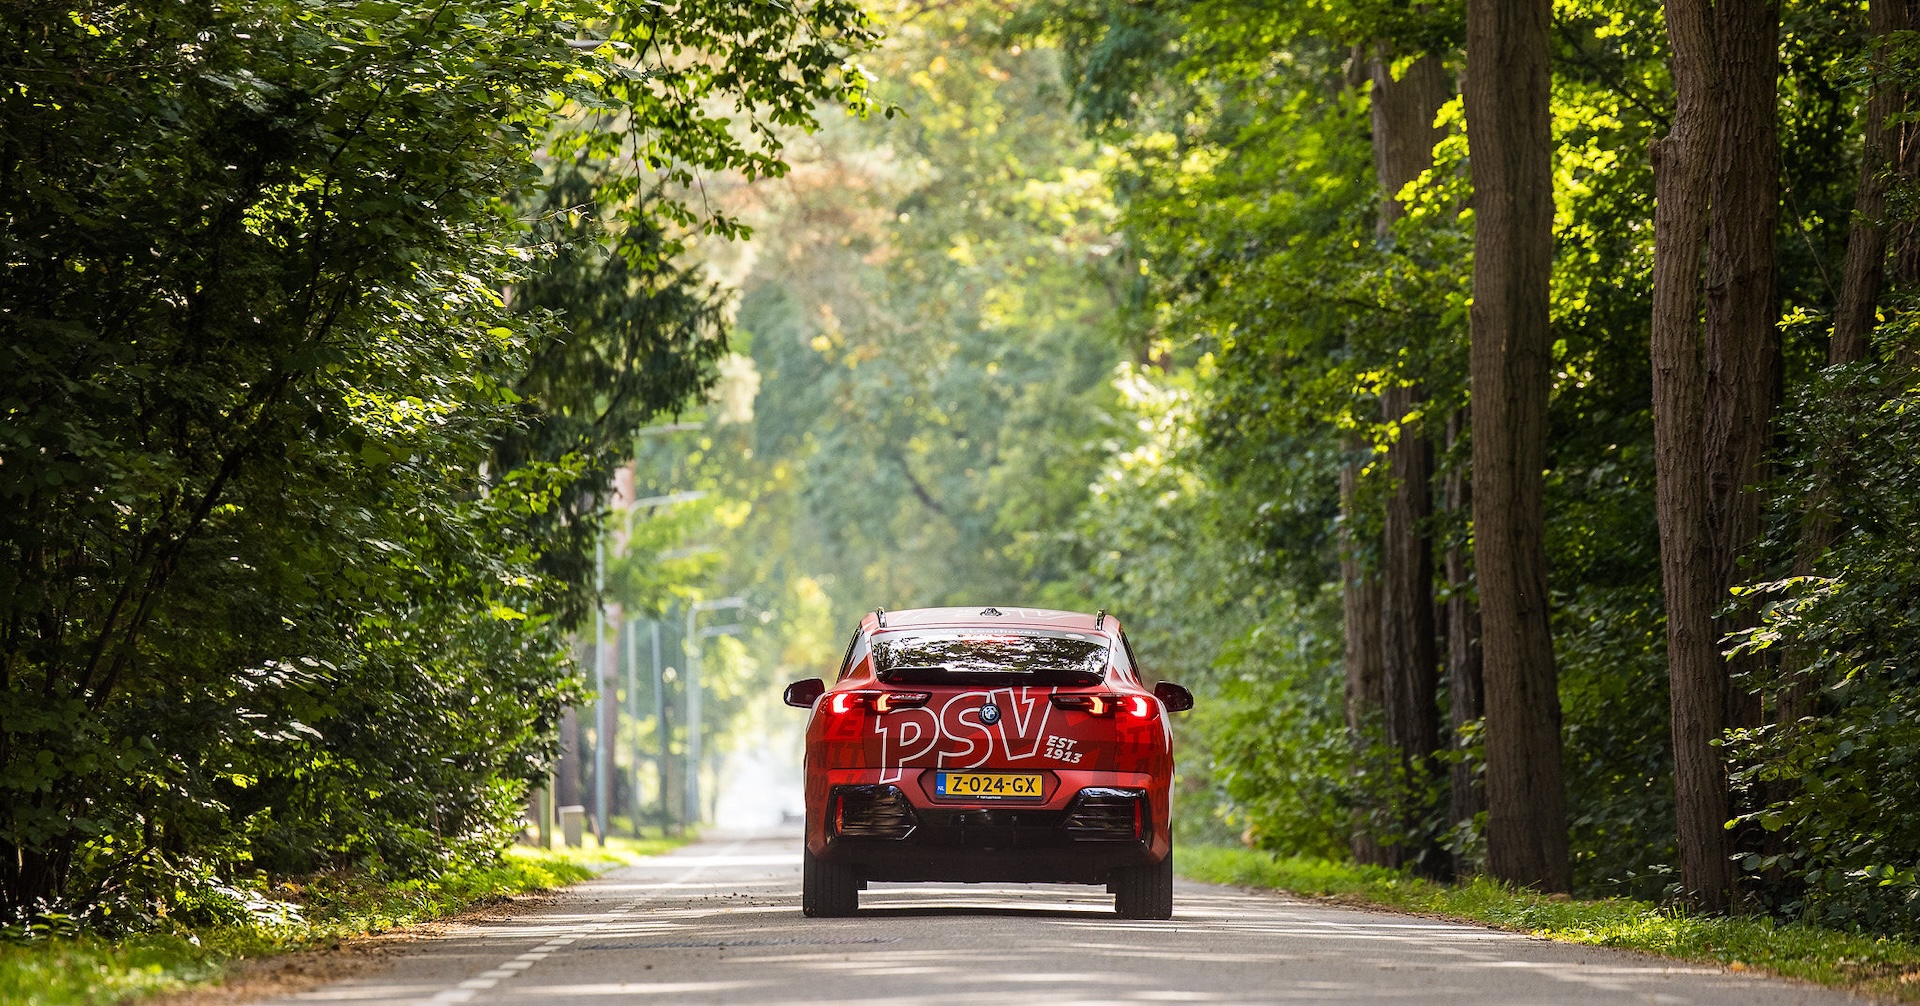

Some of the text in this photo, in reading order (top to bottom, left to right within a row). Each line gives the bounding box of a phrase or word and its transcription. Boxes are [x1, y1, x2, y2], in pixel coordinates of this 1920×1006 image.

[875, 685, 1058, 785] PSV
[1046, 735, 1077, 751] EST
[1043, 747, 1082, 764] 1913
[952, 776, 1036, 793] Z-024-GX
